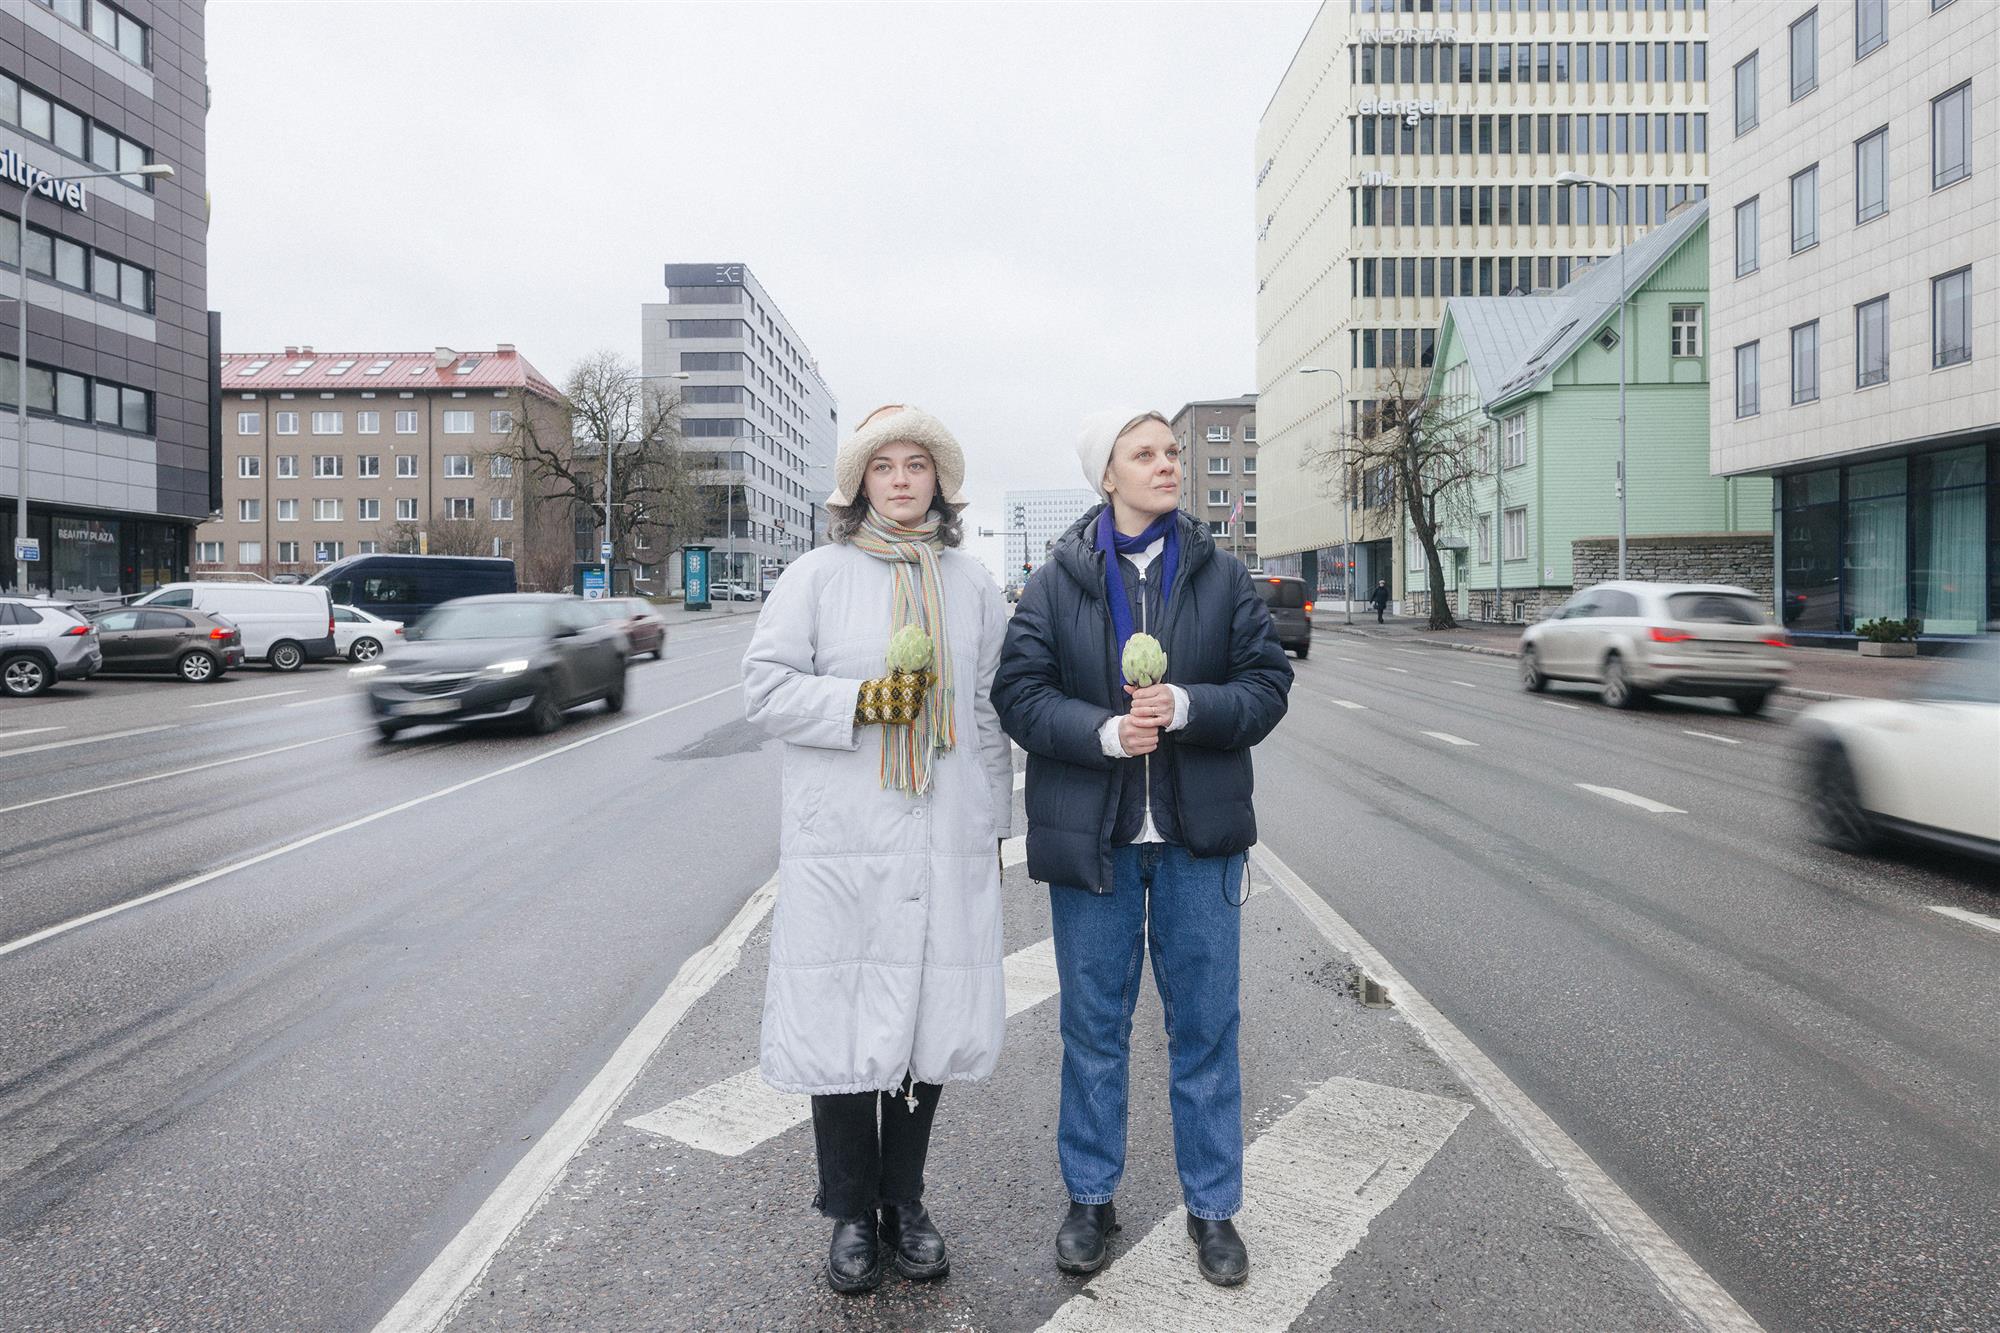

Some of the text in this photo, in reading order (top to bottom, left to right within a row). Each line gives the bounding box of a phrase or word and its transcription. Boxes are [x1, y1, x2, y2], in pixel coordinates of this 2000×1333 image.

[716, 266, 740, 283] EKE
[58, 529, 115, 543] BEAUTY PLAZA
